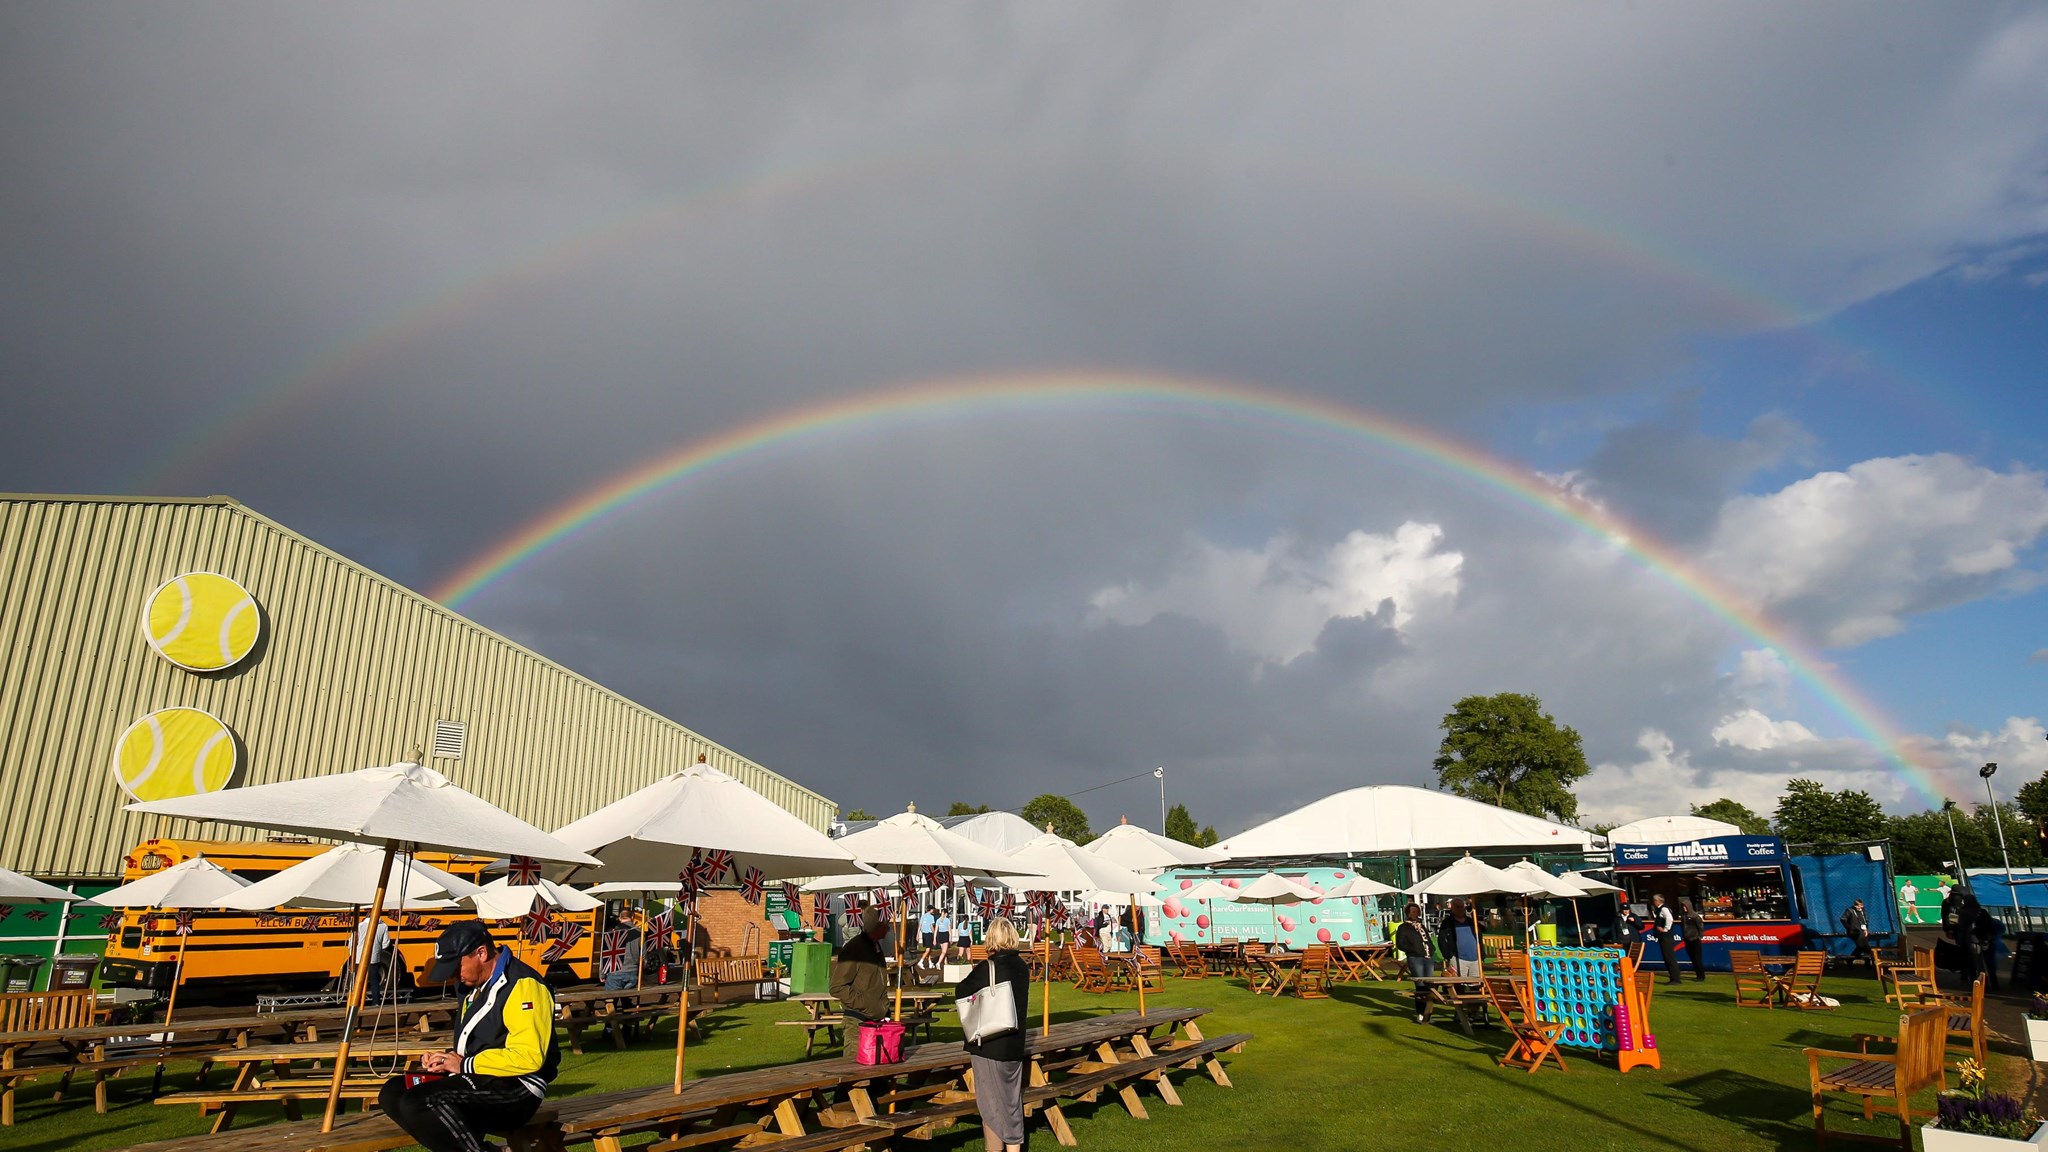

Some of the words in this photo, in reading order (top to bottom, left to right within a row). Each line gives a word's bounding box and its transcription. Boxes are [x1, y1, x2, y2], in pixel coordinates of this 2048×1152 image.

[1667, 841, 1728, 856] LAVAZZA
[1748, 848, 1775, 856] Coffee
[1624, 852, 1649, 860] Coffee
[1722, 934, 1735, 943] Say
